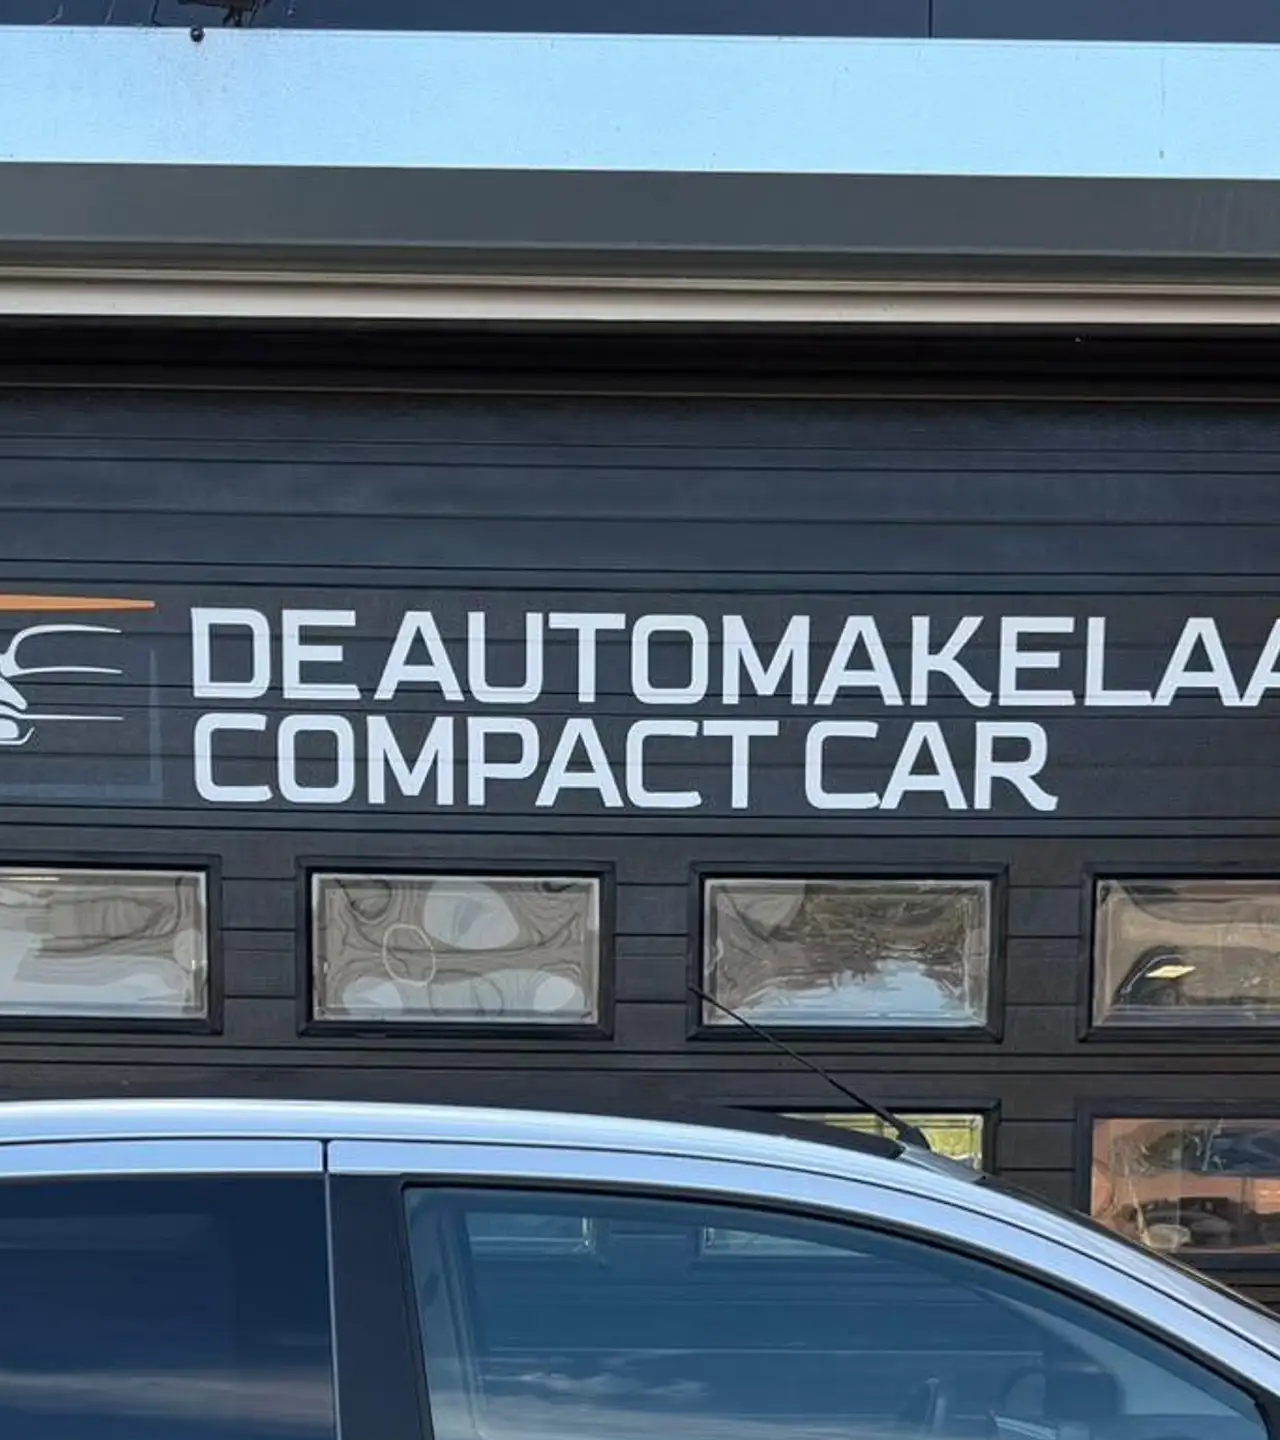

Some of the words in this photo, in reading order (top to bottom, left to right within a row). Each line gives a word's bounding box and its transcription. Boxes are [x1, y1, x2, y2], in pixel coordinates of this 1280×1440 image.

[191, 607, 361, 700] DE
[194, 711, 777, 808] COMPACT
[805, 721, 1059, 810] CAR
